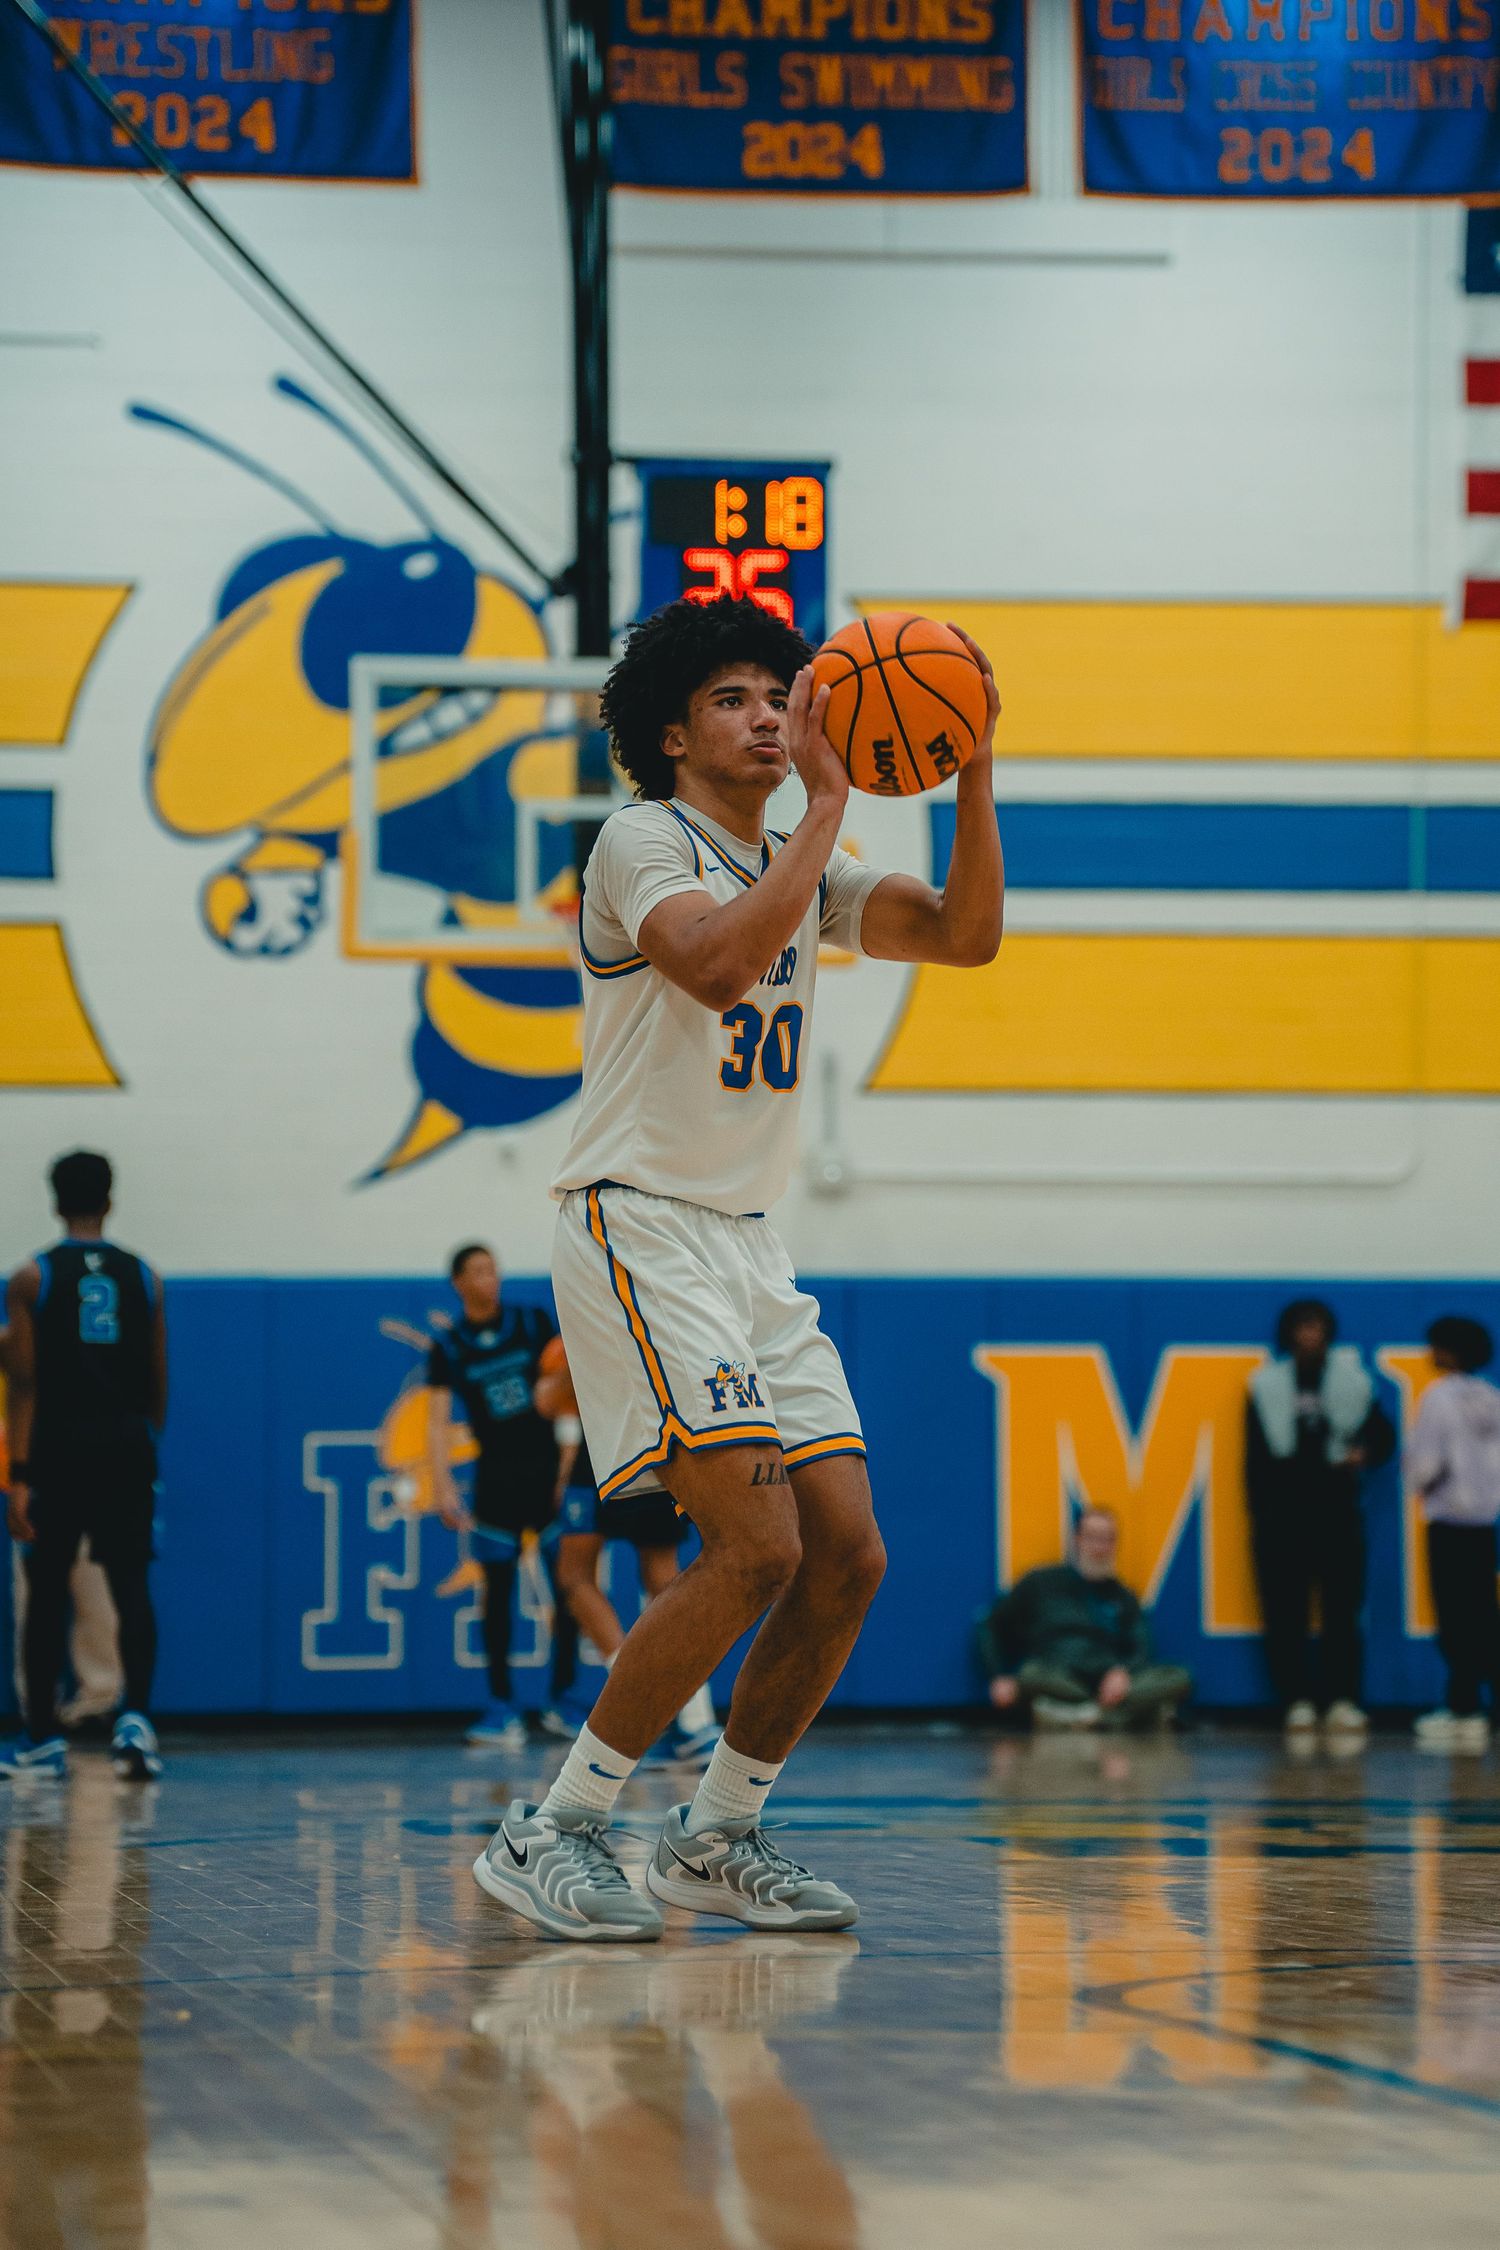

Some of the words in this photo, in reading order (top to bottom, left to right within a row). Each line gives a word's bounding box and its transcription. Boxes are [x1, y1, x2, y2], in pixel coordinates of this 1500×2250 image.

[48, 18, 334, 84] WRESTLING
[627, 0, 995, 42] CHAMPIONS
[1097, 0, 1492, 42] CHAMPIONS
[110, 90, 276, 153] 2024
[742, 120, 885, 180] 2024
[1218, 126, 1376, 184] 2024
[715, 476, 824, 550] 1:18
[683, 548, 794, 630] 25
[718, 1000, 804, 1093] 30
[78, 1274, 120, 1344] 2
[703, 1373, 766, 1413] FM
